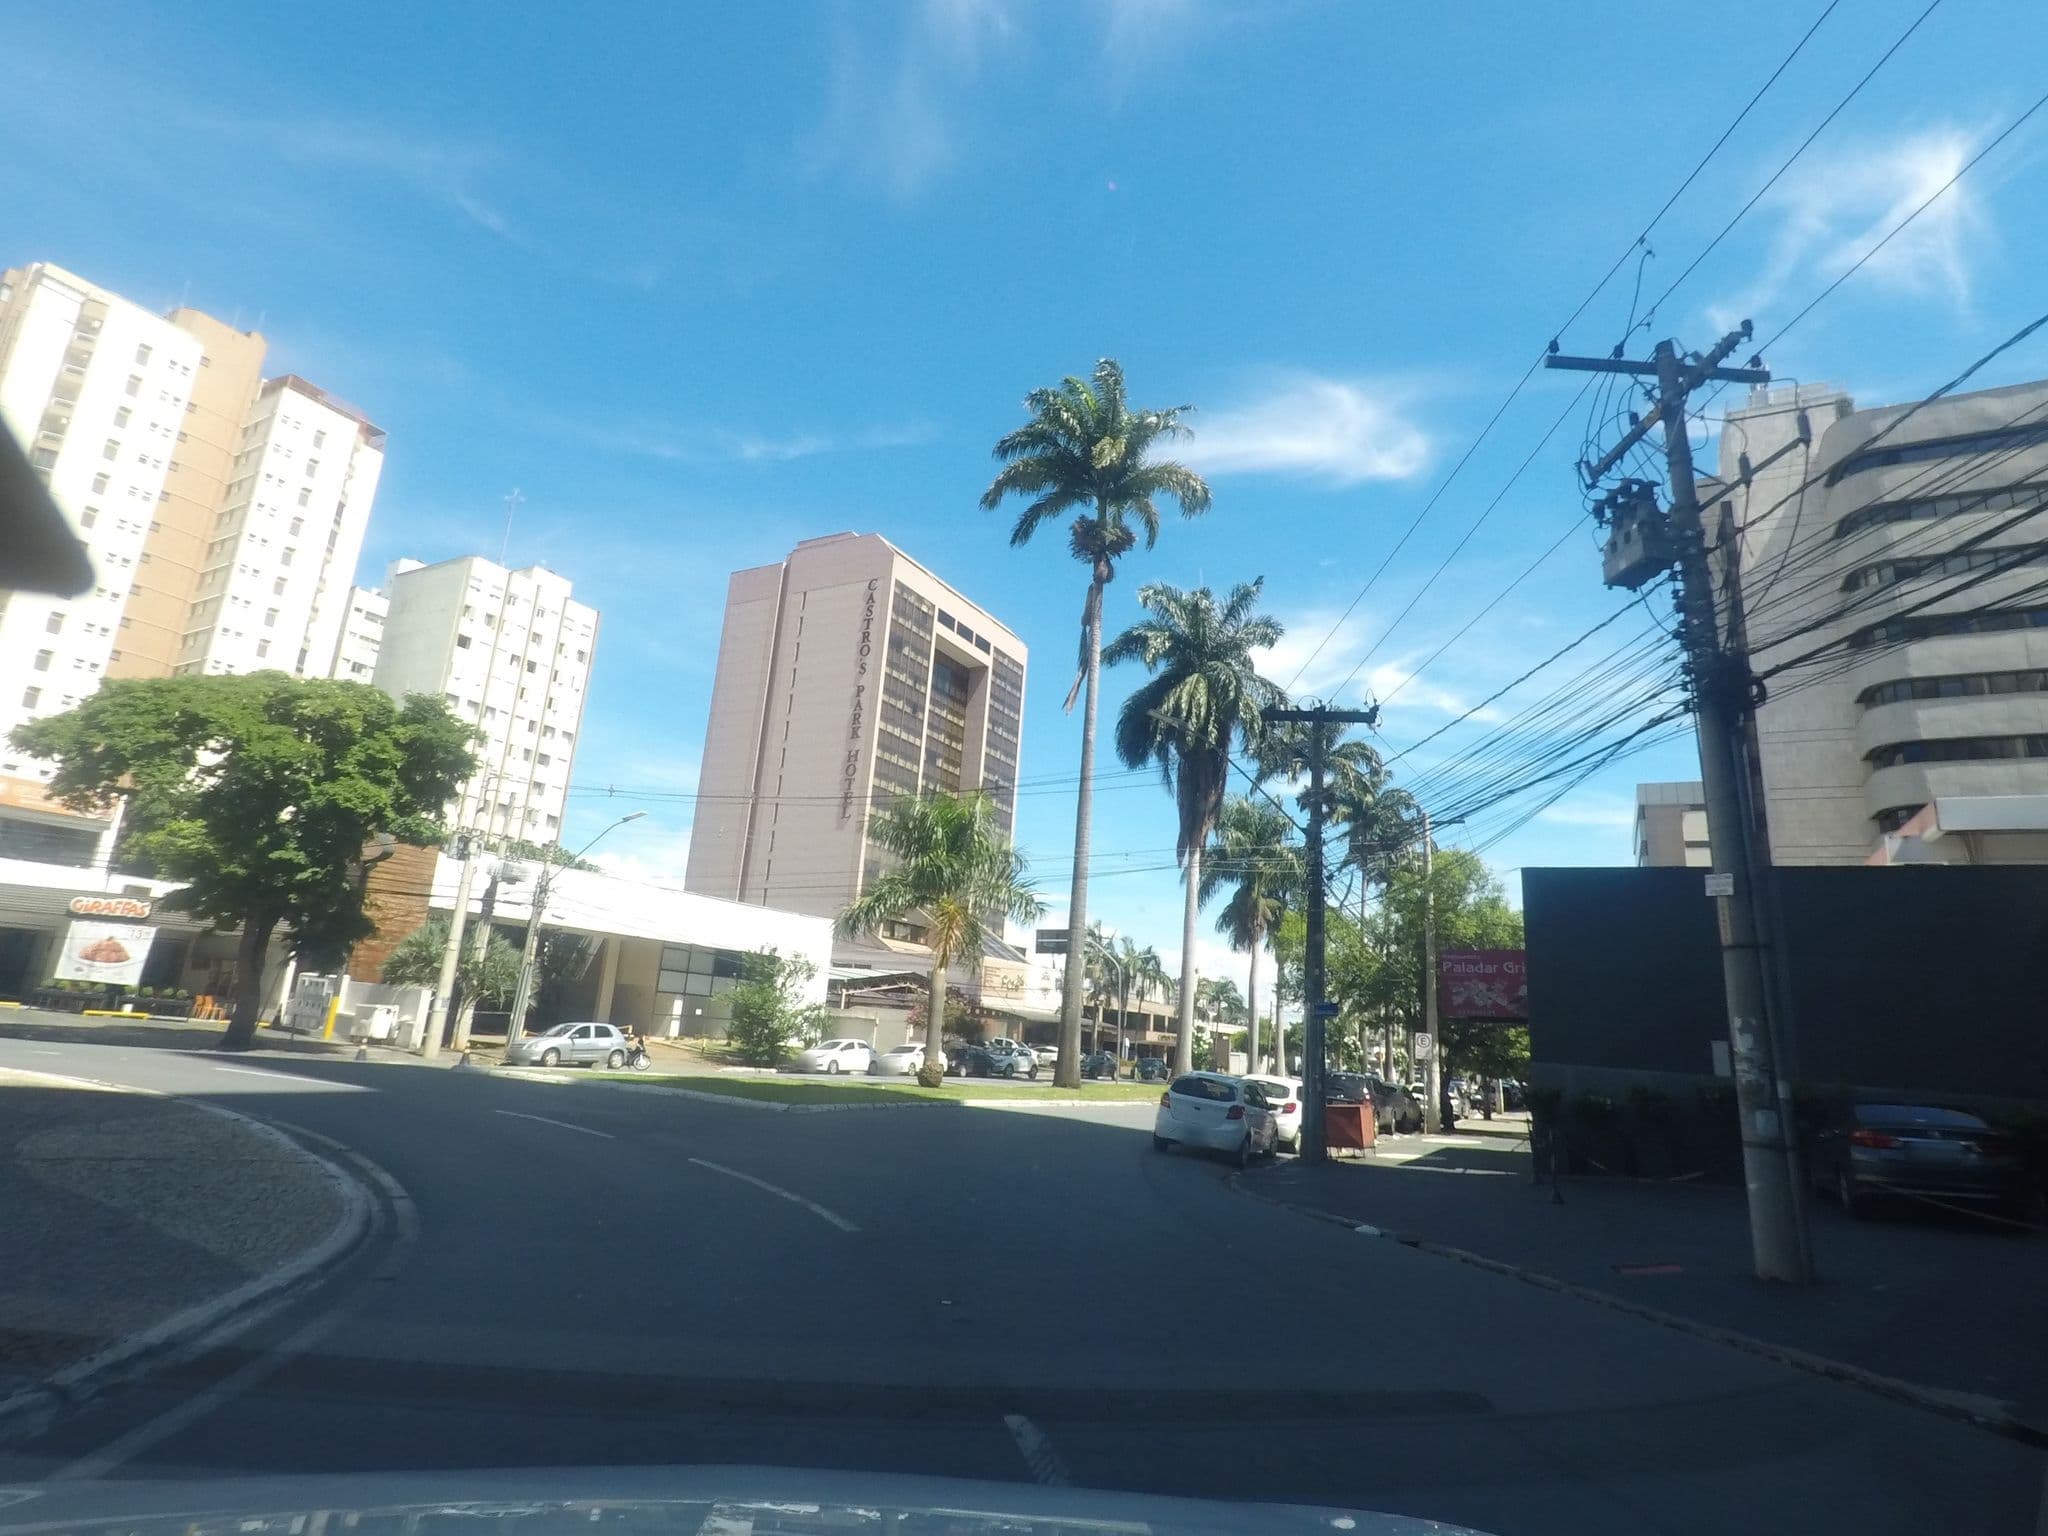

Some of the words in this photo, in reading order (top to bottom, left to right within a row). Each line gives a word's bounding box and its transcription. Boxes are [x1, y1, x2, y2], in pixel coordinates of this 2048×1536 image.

[858, 578, 878, 676] CASTRO'S
[850, 684, 865, 739] PARK
[841, 749, 859, 819] HOTEL
[1442, 961, 1499, 974] Paladar
